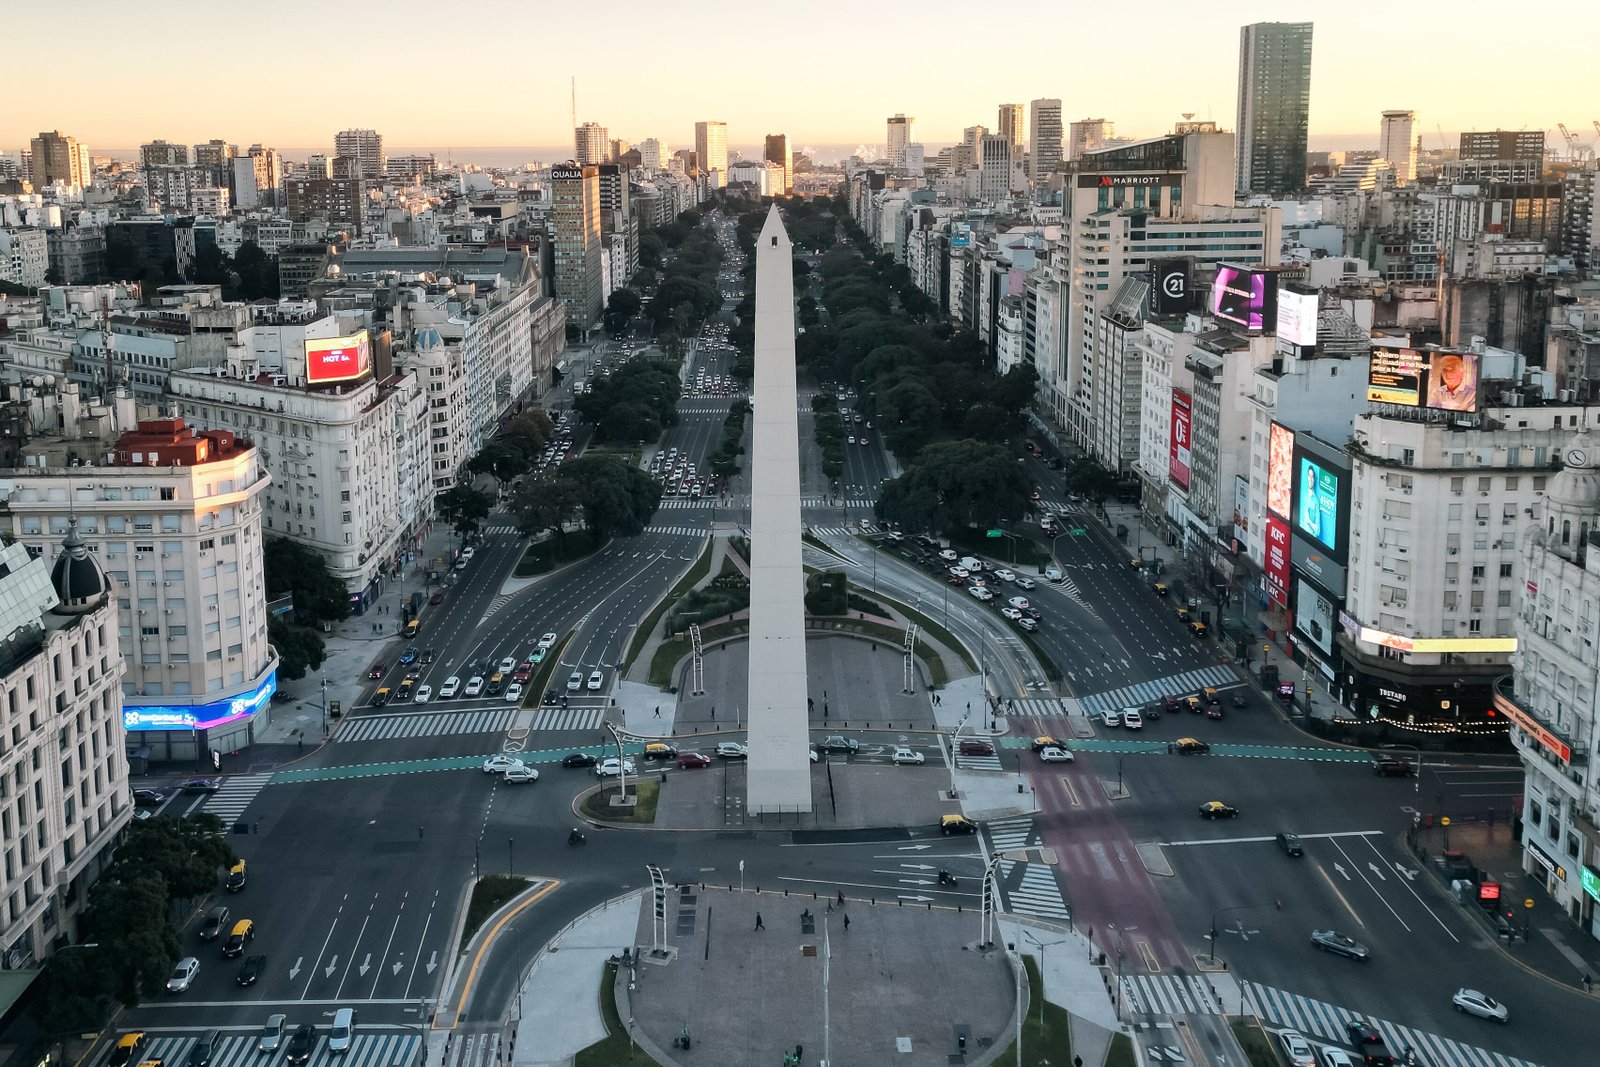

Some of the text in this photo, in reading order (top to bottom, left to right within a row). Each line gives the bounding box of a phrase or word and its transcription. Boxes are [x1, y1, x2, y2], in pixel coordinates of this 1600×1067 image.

[552, 170, 582, 179] QUALIA
[1113, 177, 1160, 185] MARRIOTT
[323, 355, 339, 363] HOT
[1270, 526, 1286, 545] KFC
[1268, 585, 1279, 599] KFC
[1379, 688, 1407, 702] TOSTADO
[1529, 844, 1555, 872] McDonald's
